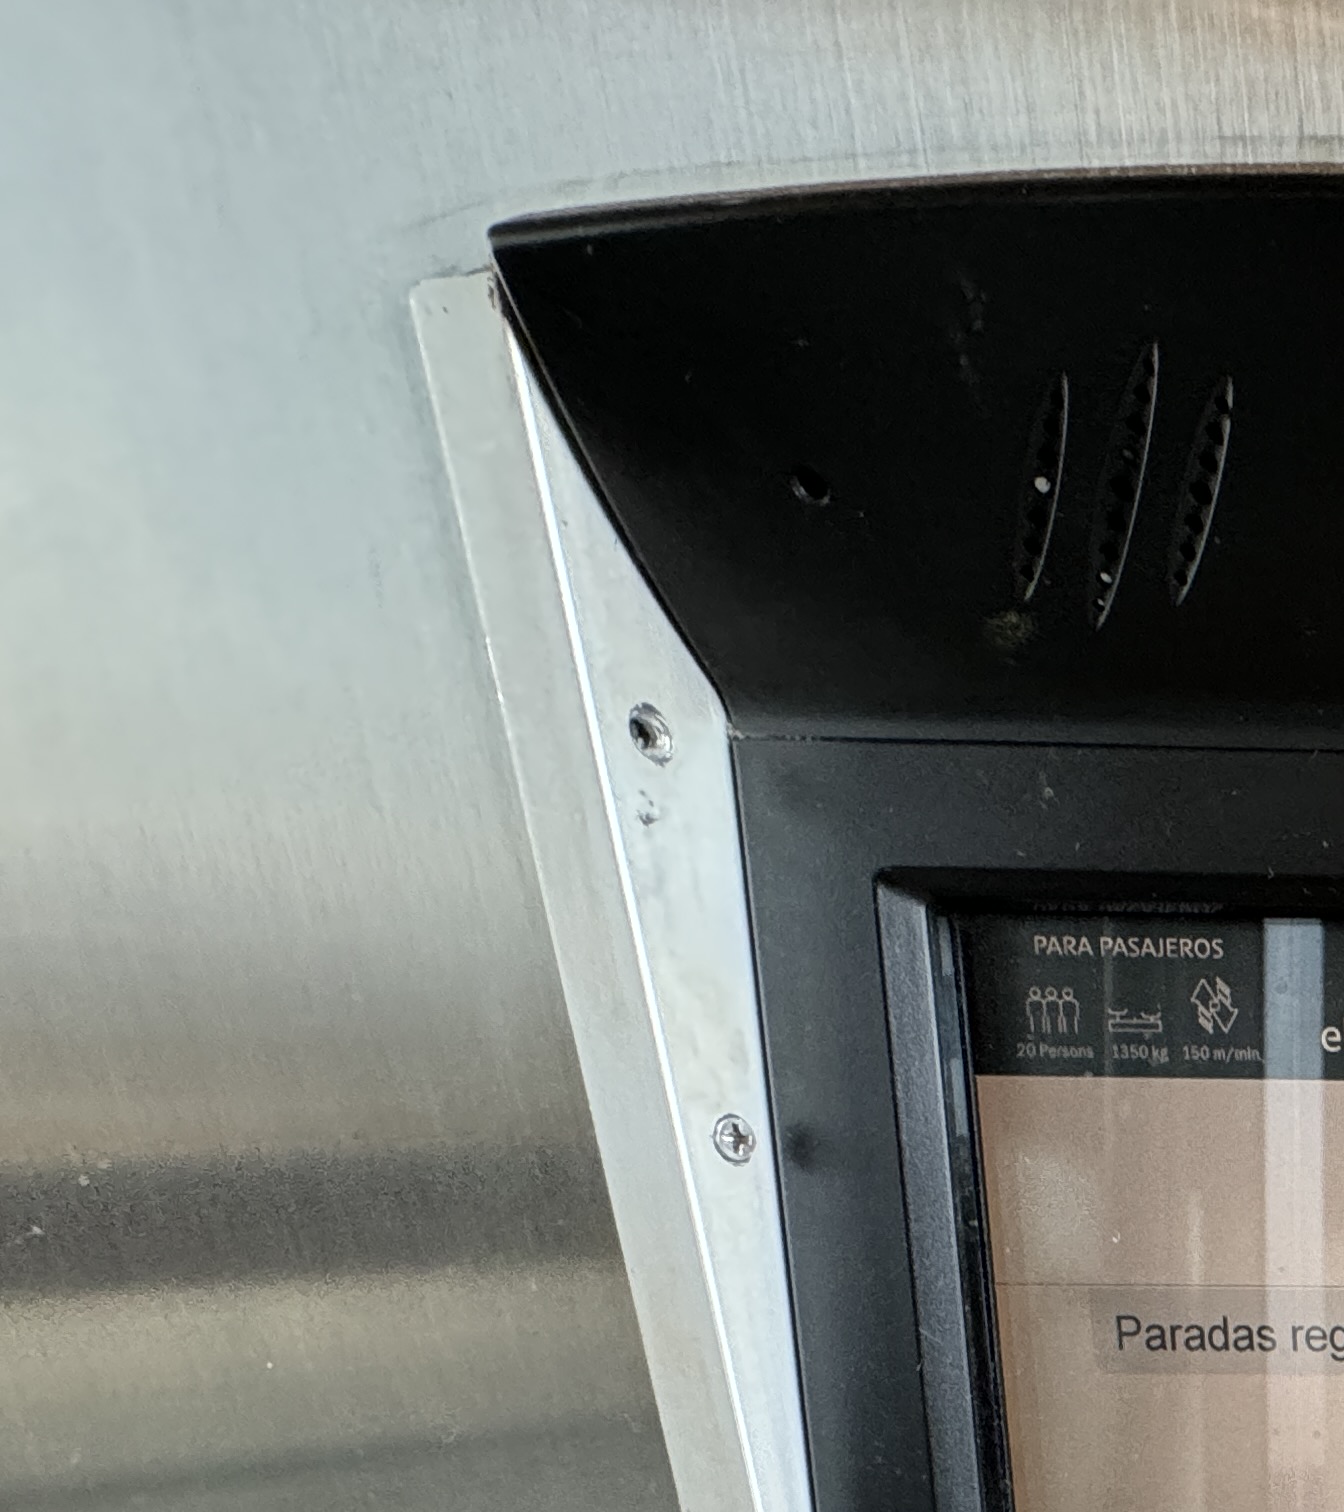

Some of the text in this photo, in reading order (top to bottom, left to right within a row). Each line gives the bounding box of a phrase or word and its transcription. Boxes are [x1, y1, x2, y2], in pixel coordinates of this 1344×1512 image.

[1033, 934, 1224, 960] PARA PASAJEROS
[1016, 1042, 1036, 1059] 20
[1112, 1043, 1170, 1064] 1350 kg
[1182, 1045, 1209, 1061] 150
[1115, 1314, 1276, 1353] Paradas
